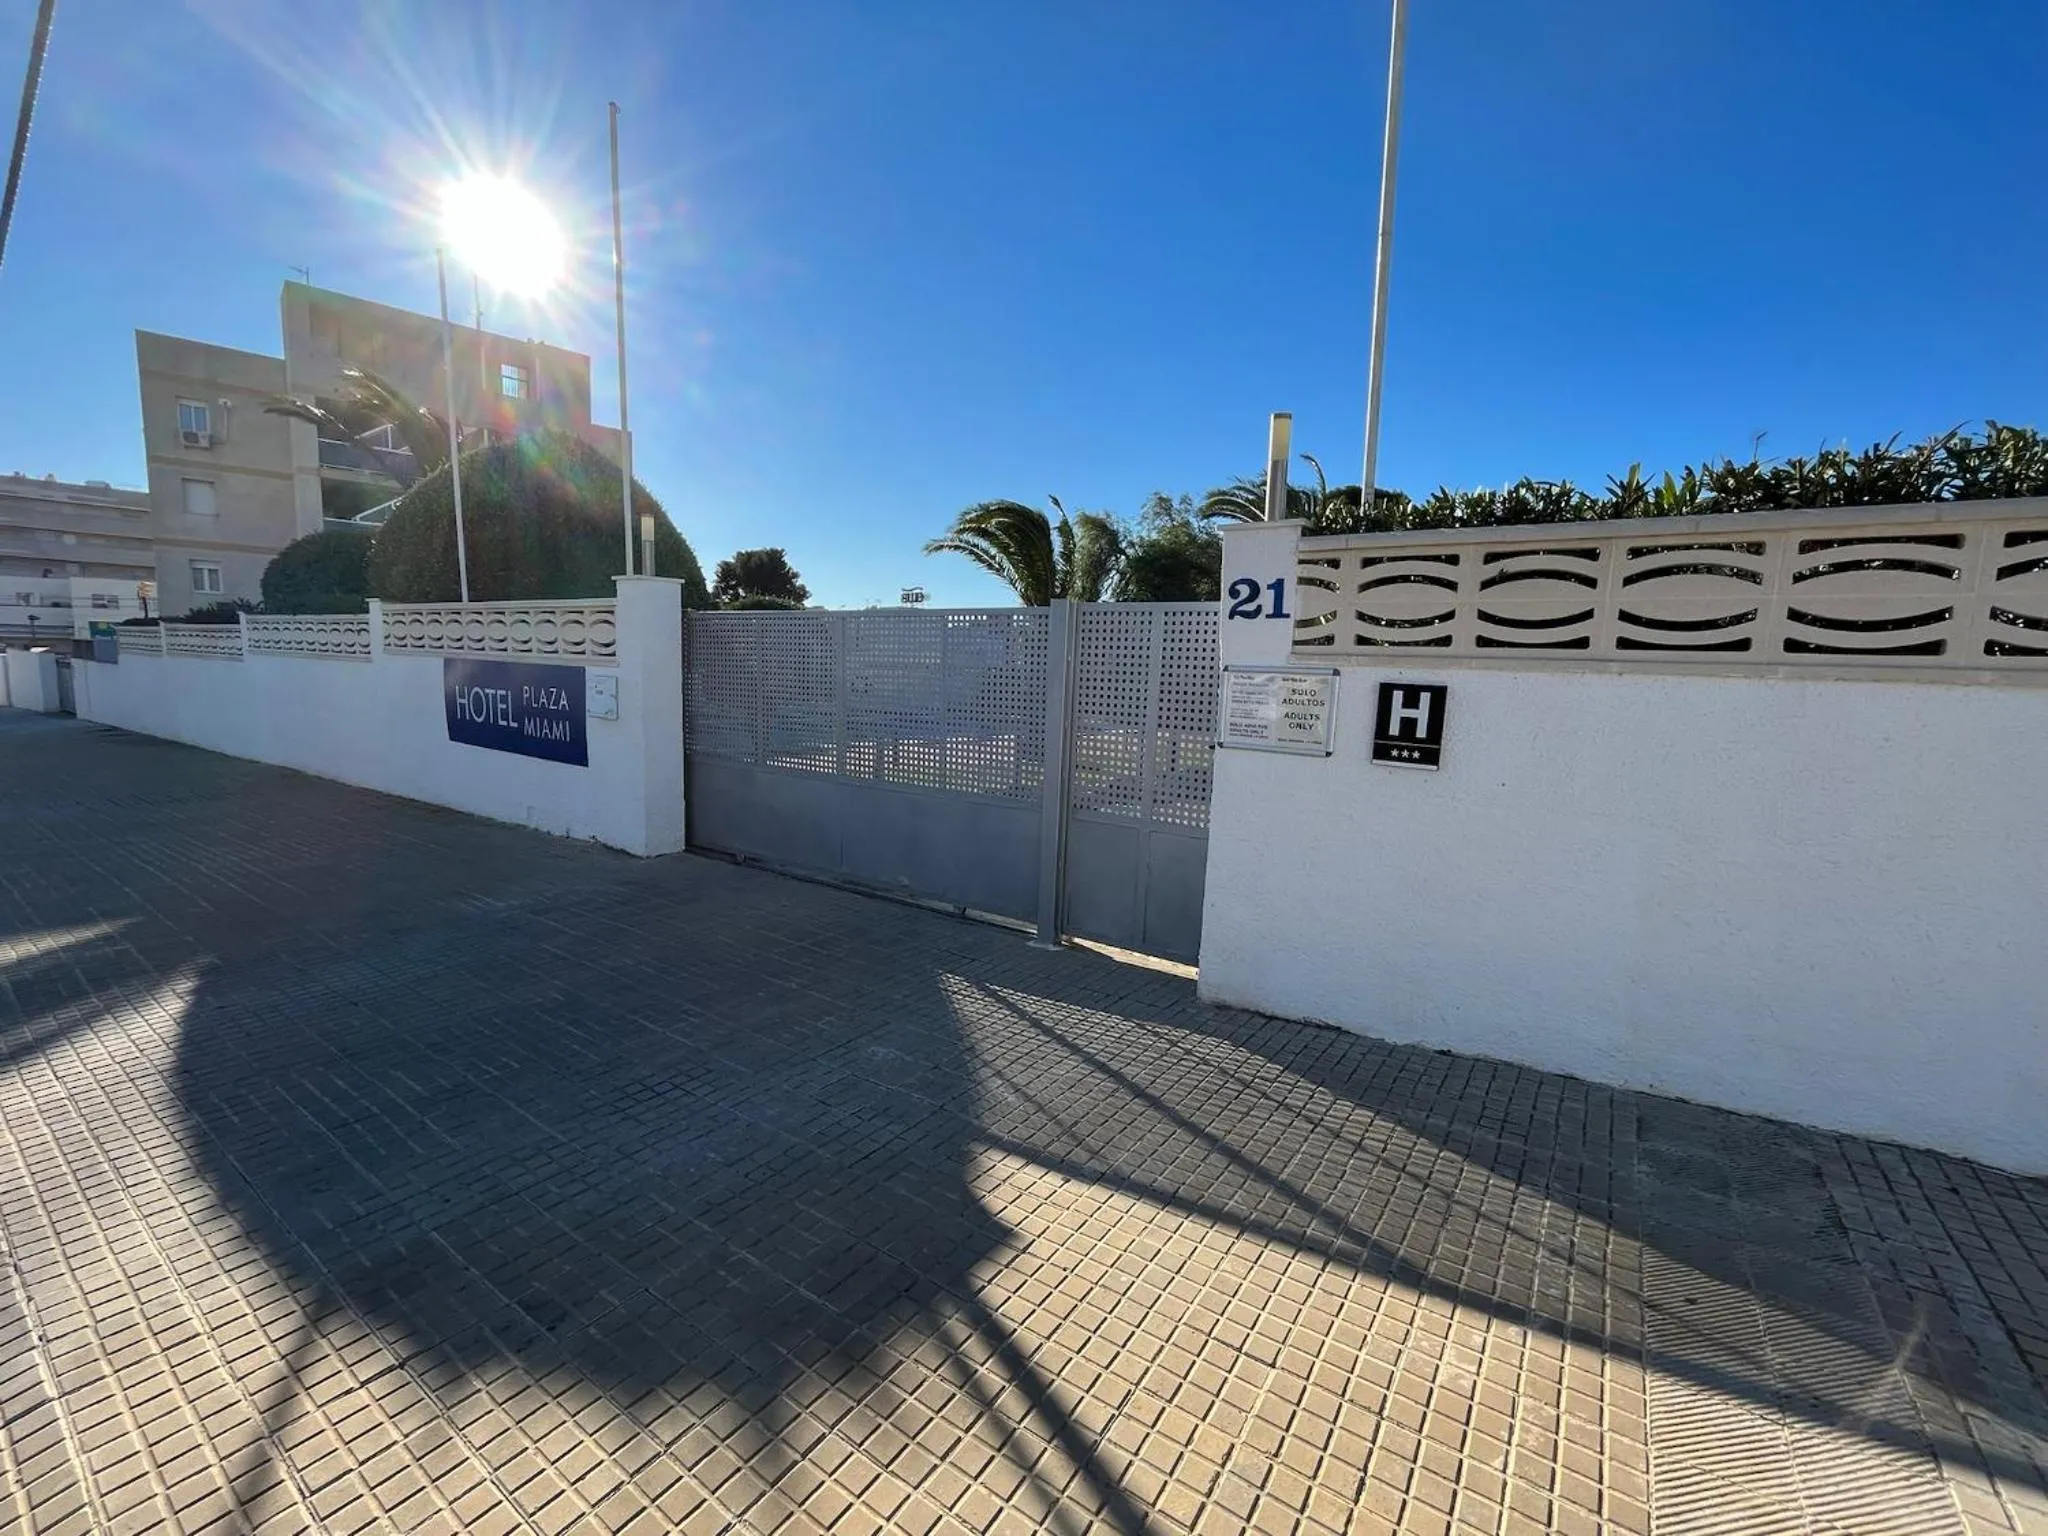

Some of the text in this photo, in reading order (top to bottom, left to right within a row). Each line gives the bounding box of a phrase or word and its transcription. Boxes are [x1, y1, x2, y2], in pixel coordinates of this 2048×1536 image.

[1228, 578, 1291, 620] 21
[454, 686, 519, 728] HOTEL
[523, 685, 569, 710] PLAZA
[1281, 698, 1326, 707] ADULTOS
[1283, 712, 1321, 721] ADULTS
[1288, 722, 1315, 731] ONLY
[1389, 690, 1432, 738] H
[524, 717, 570, 742] MIAMI
